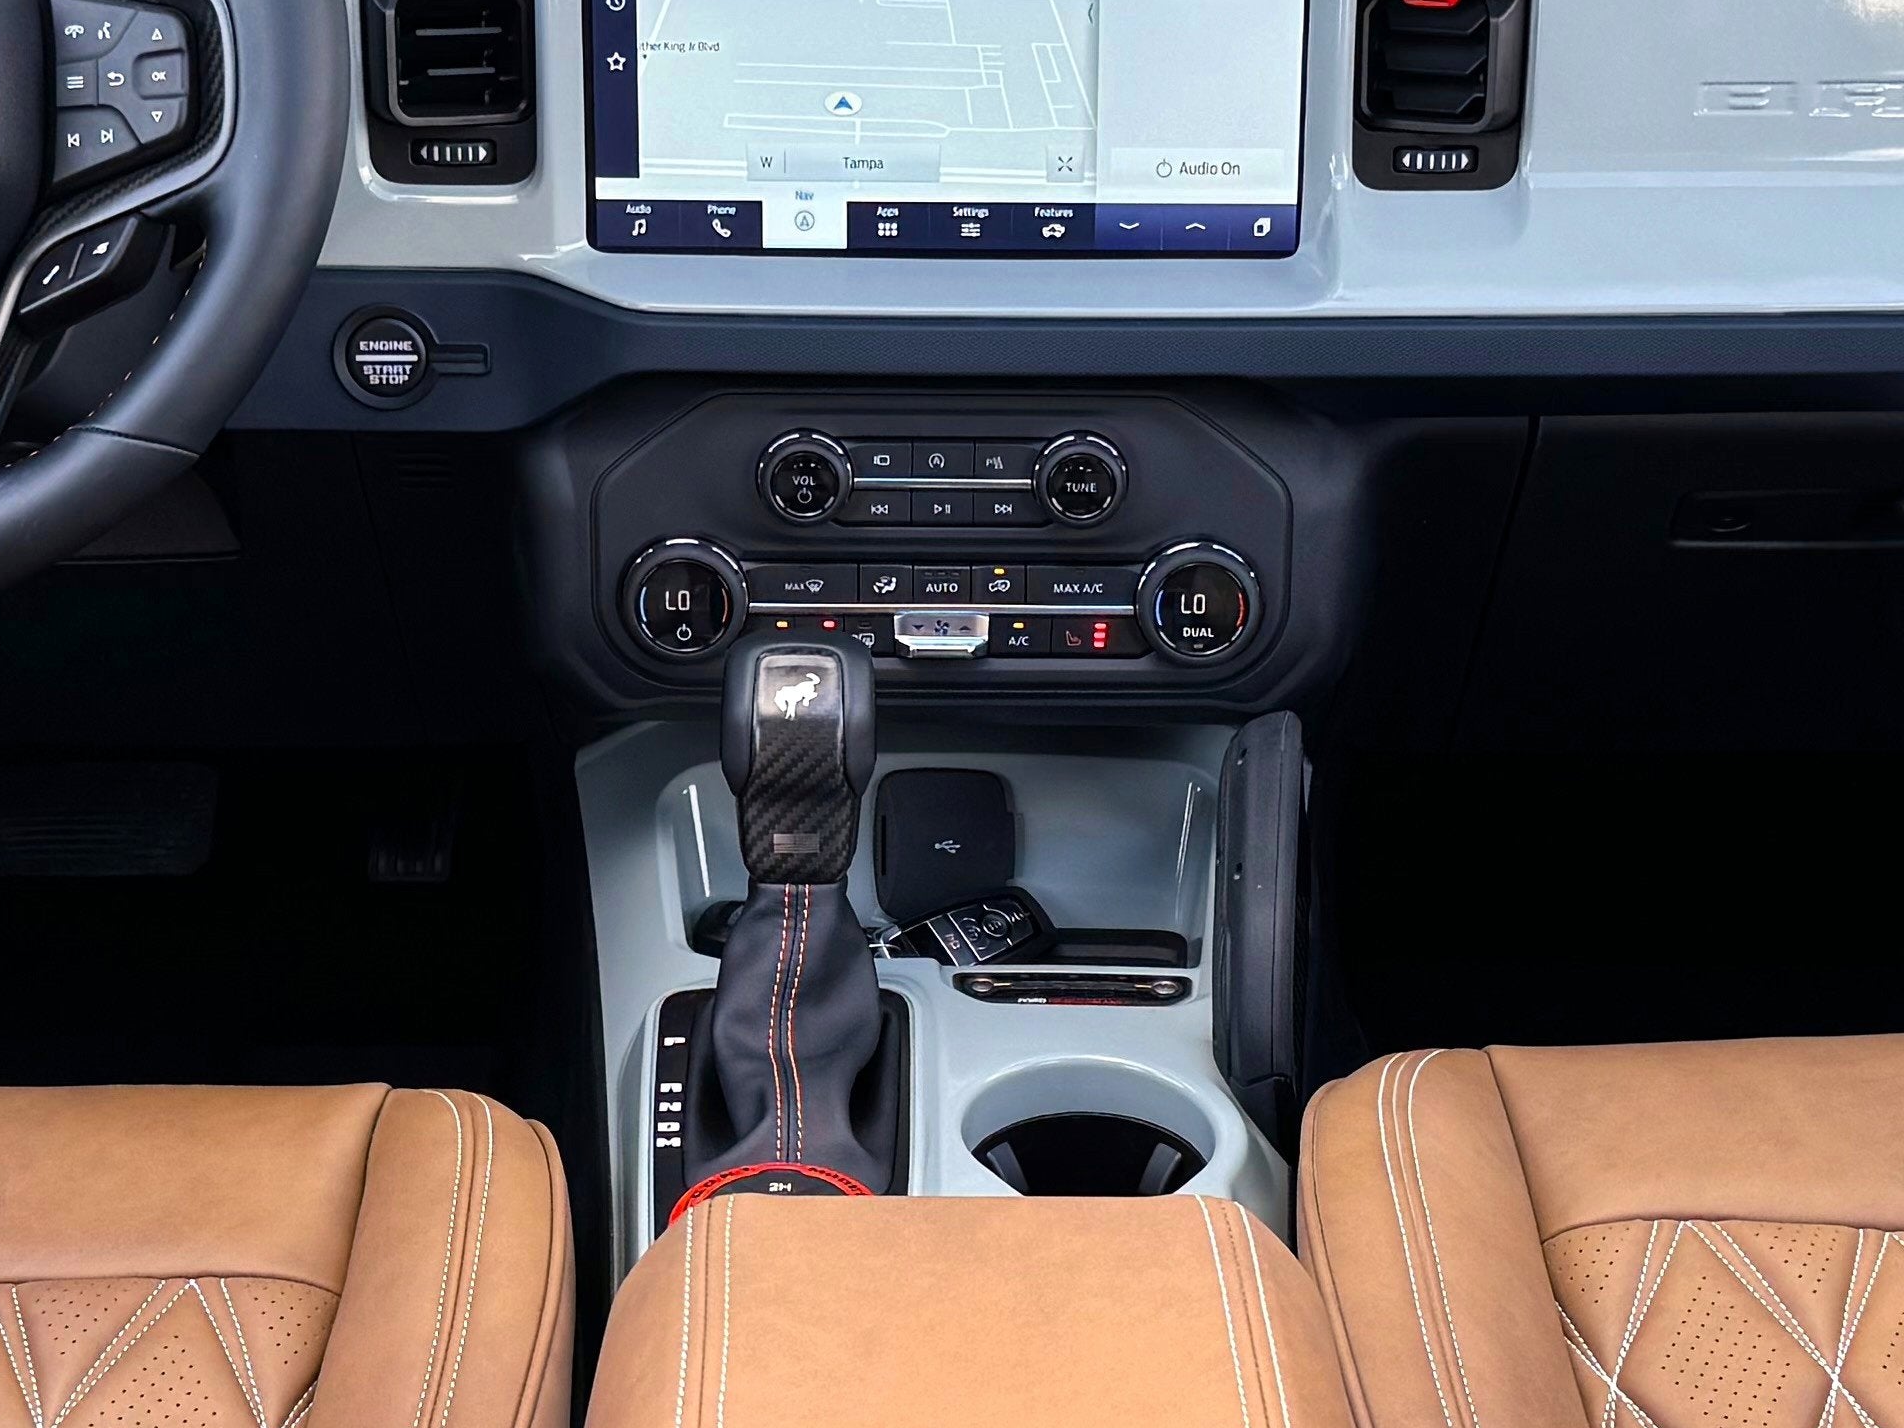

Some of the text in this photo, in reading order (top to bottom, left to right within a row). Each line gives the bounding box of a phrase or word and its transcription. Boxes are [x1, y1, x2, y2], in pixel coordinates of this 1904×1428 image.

[663, 42, 686, 54] King
[698, 41, 720, 52] Blvd
[151, 71, 166, 82] OK
[760, 156, 773, 169] W
[843, 156, 884, 171] Tampa
[1179, 161, 1241, 176] Audio On
[795, 190, 815, 201] Nav
[625, 203, 652, 215] Audio
[707, 203, 736, 215] Phone
[876, 205, 899, 218] Apps
[952, 206, 990, 219] Settings
[1034, 206, 1074, 218] Features
[359, 341, 413, 352] ENGINE
[362, 364, 412, 375] START
[369, 374, 409, 385] STOP
[792, 475, 816, 486] VOL
[1065, 481, 1097, 493] TUNE
[925, 582, 958, 593] AUTO
[1053, 583, 1103, 594] MAX A/C
[664, 590, 691, 611] LO
[1180, 593, 1206, 615] LO
[1182, 627, 1214, 638] DUAL
[1008, 636, 1029, 647] A/C
[658, 1101, 681, 1112] N
[657, 1121, 680, 1132] D
[656, 1136, 681, 1148] M
[768, 1182, 792, 1192] 2H
